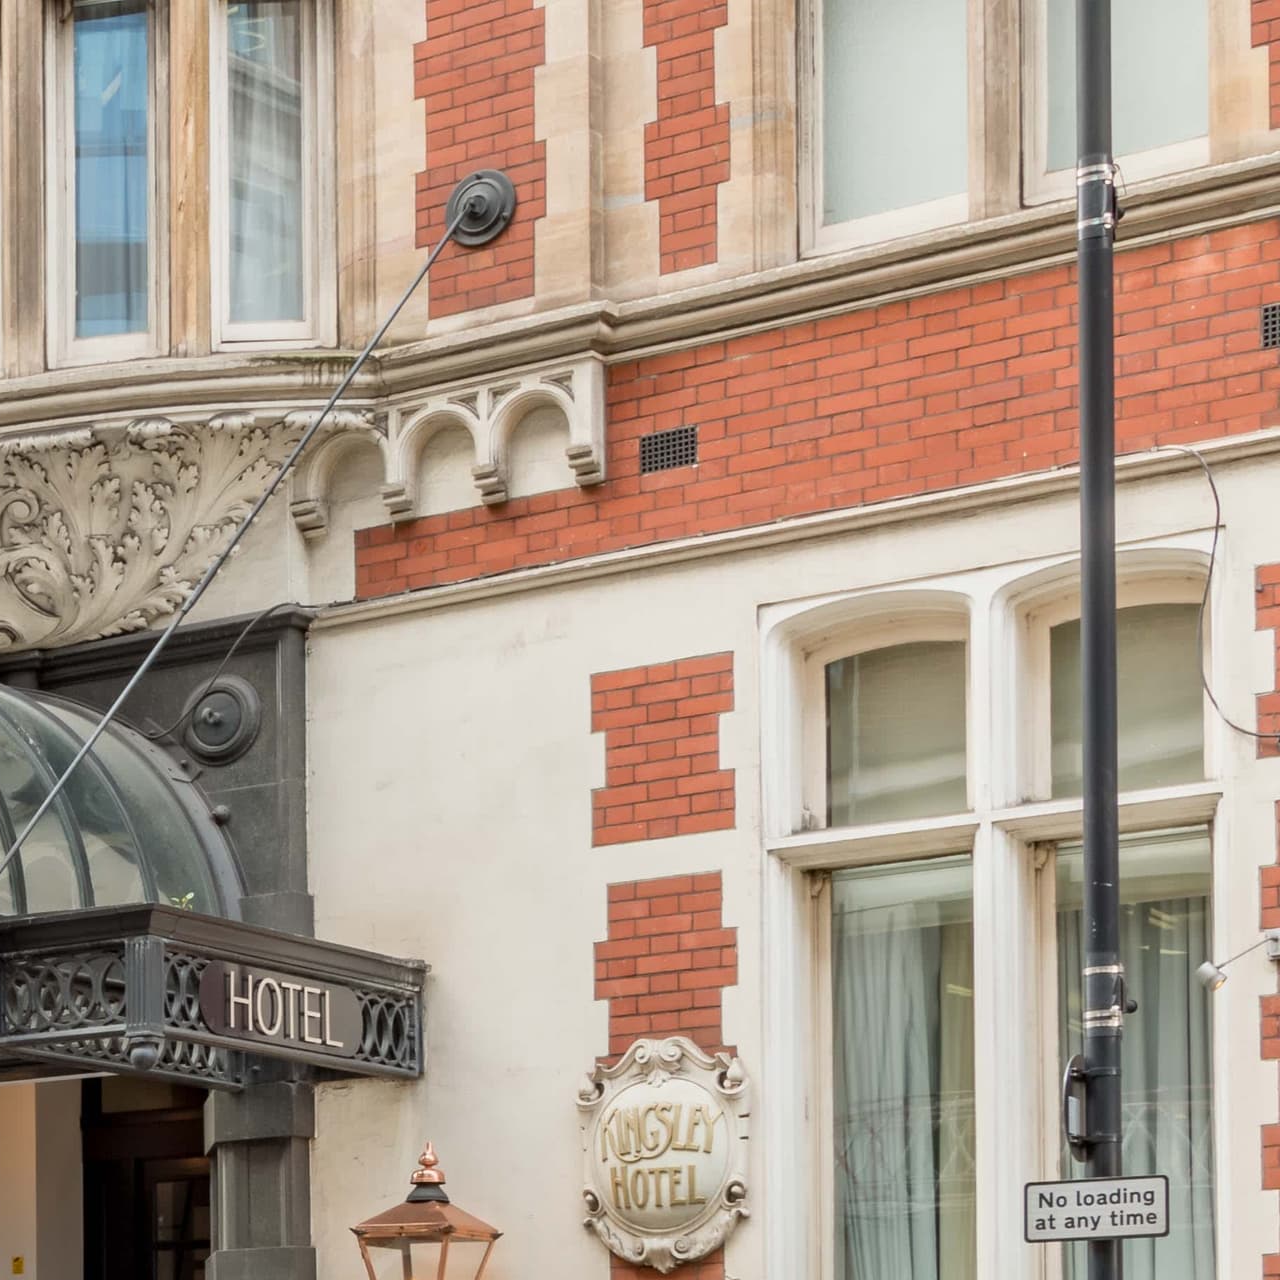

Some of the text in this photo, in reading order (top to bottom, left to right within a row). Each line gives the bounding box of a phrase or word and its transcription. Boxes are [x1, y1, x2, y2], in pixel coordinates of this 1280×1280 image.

[230, 971, 344, 1047] HOTEL
[600, 1103, 725, 1164] KINGSLEY
[610, 1163, 706, 1209] HOTEL
[1038, 1187, 1155, 1209] No loading
[1035, 1210, 1158, 1231] at any time
